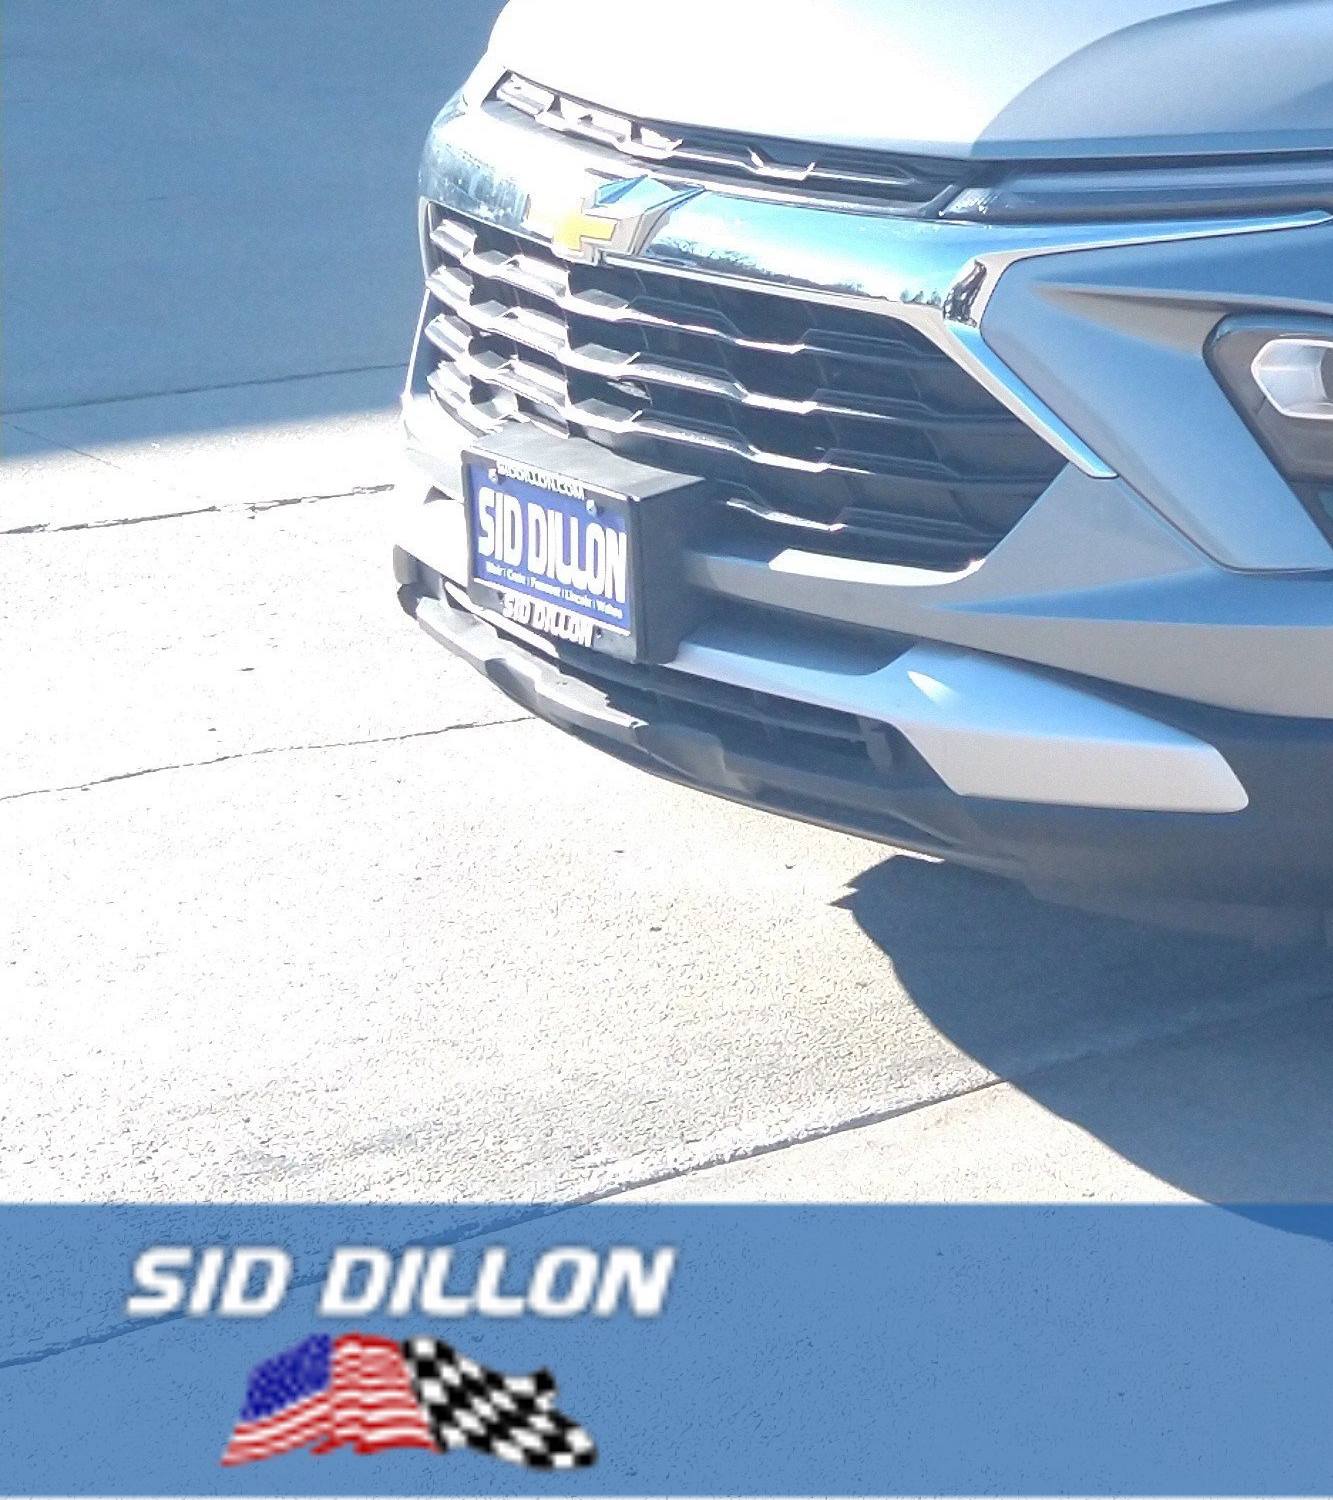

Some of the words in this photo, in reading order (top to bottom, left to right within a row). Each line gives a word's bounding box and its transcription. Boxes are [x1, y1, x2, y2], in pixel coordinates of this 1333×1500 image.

[478, 486, 523, 567] SID
[527, 503, 627, 604] DILLON
[502, 592, 530, 625] SID
[532, 601, 594, 647] DILLON
